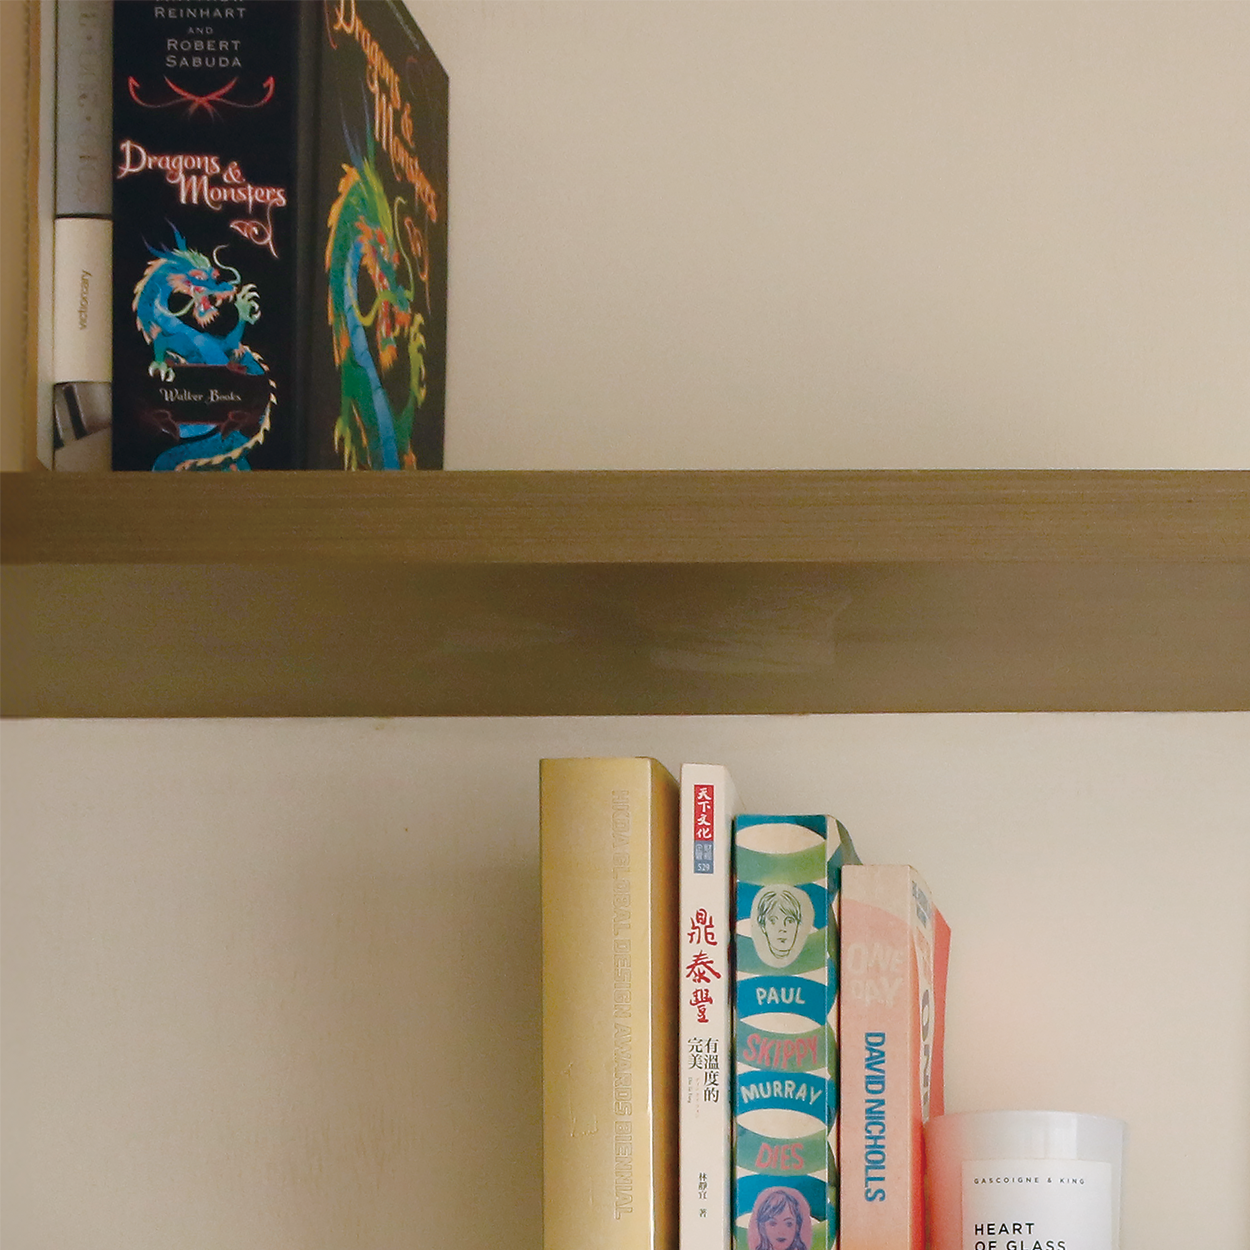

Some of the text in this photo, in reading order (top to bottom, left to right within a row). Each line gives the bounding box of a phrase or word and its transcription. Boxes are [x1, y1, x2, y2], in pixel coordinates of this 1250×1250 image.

[154, 6, 247, 19] REINHART
[166, 39, 242, 51] ROBERT
[187, 26, 214, 35] AND
[165, 55, 243, 68] SABUDA
[116, 140, 246, 184] Dragons &
[178, 174, 287, 214] Monsters
[158, 387, 242, 403] Walker Books
[696, 786, 713, 840] 天下文化
[612, 938, 633, 1018] DESIGN
[685, 907, 722, 1024] 鼎泰豐
[755, 987, 806, 1006] PAUL
[687, 1037, 703, 1070] 完美
[742, 1032, 819, 1070] SKIPPY
[703, 1037, 720, 1104] 有溫度的
[740, 1080, 823, 1105] MURRAY
[864, 1032, 887, 1203] DAVID NICHOLLS
[754, 1142, 805, 1171] DIES
[973, 1176, 1040, 1185] GASCOIGNE
[1059, 1177, 1086, 1185] KING
[974, 1222, 1035, 1236] HEART
